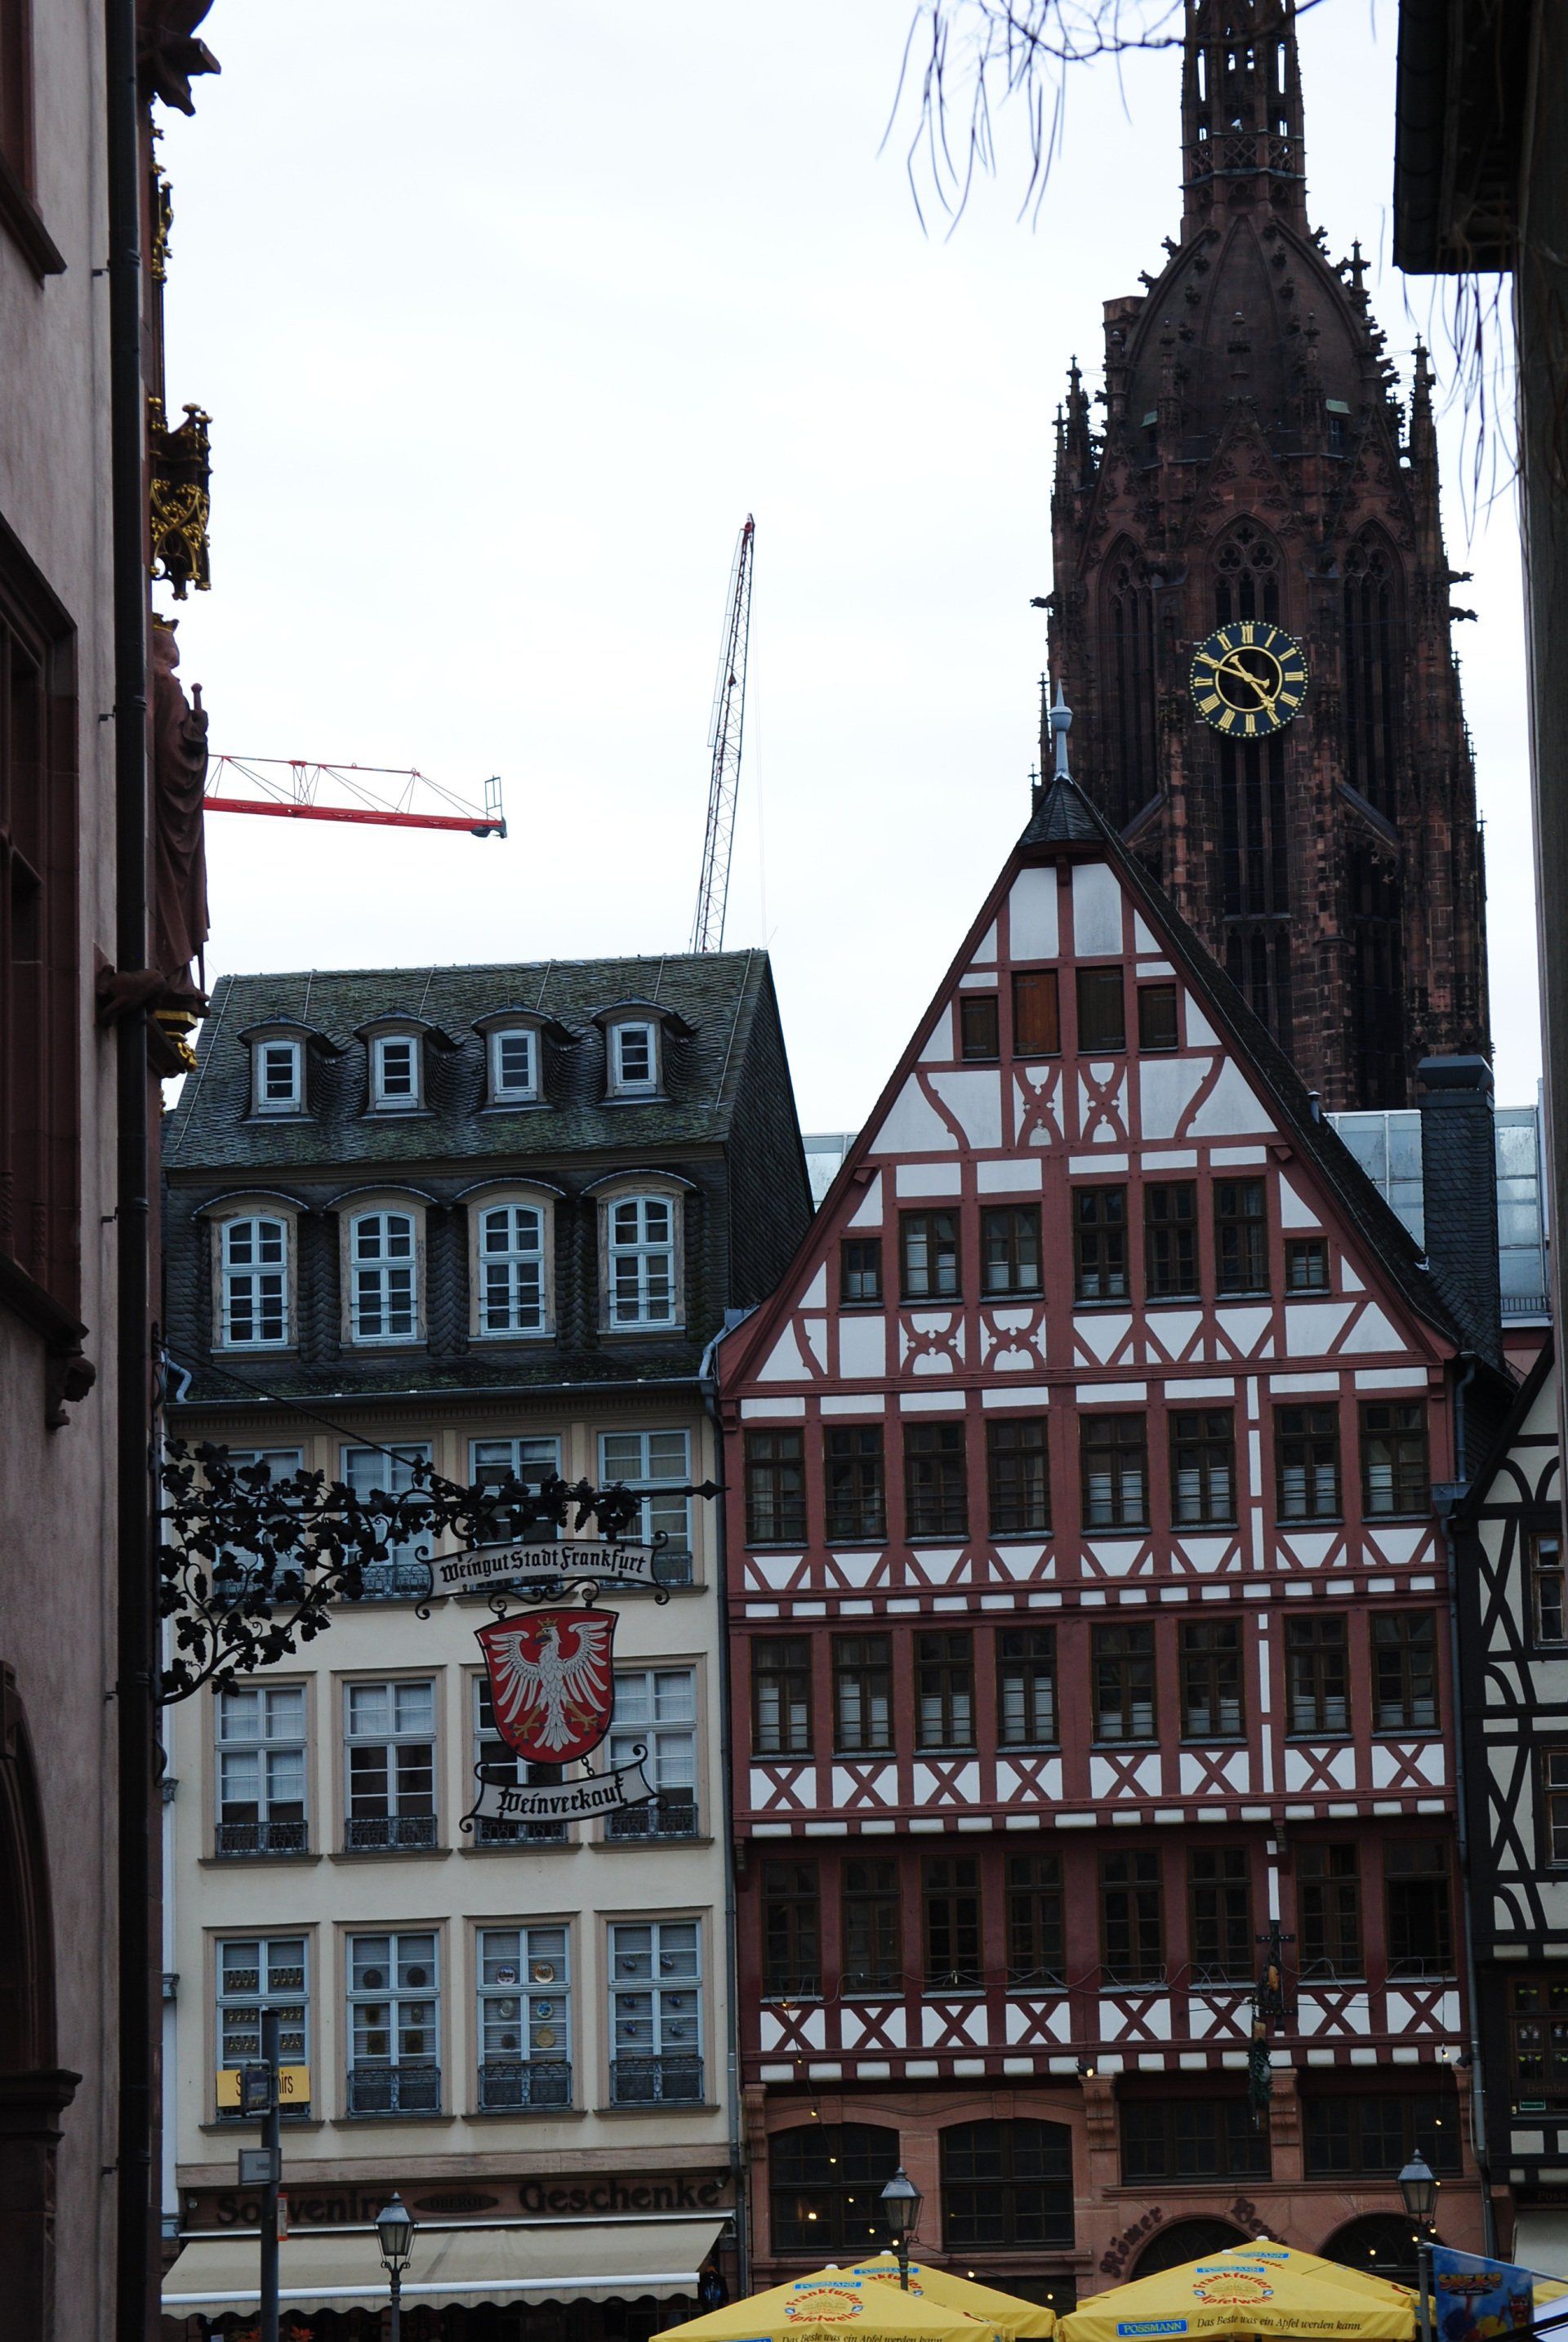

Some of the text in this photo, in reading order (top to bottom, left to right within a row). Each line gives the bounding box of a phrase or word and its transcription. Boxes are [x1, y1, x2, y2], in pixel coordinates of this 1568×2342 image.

[439, 1547, 647, 1583] Weingut Stadt Frankfurt
[497, 1775, 627, 1814] Weinverkauf
[218, 2188, 395, 2224] Sovenir
[519, 2178, 719, 2213] Geschenke
[1192, 2272, 1272, 2289] Frankfurter
[785, 2288, 863, 2306] Frankfurter
[1124, 2322, 1182, 2334] POSSMANN
[1197, 2315, 1363, 2331] Das Beste was ein Apfel werden kann.
[844, 2334, 858, 2342] ein
